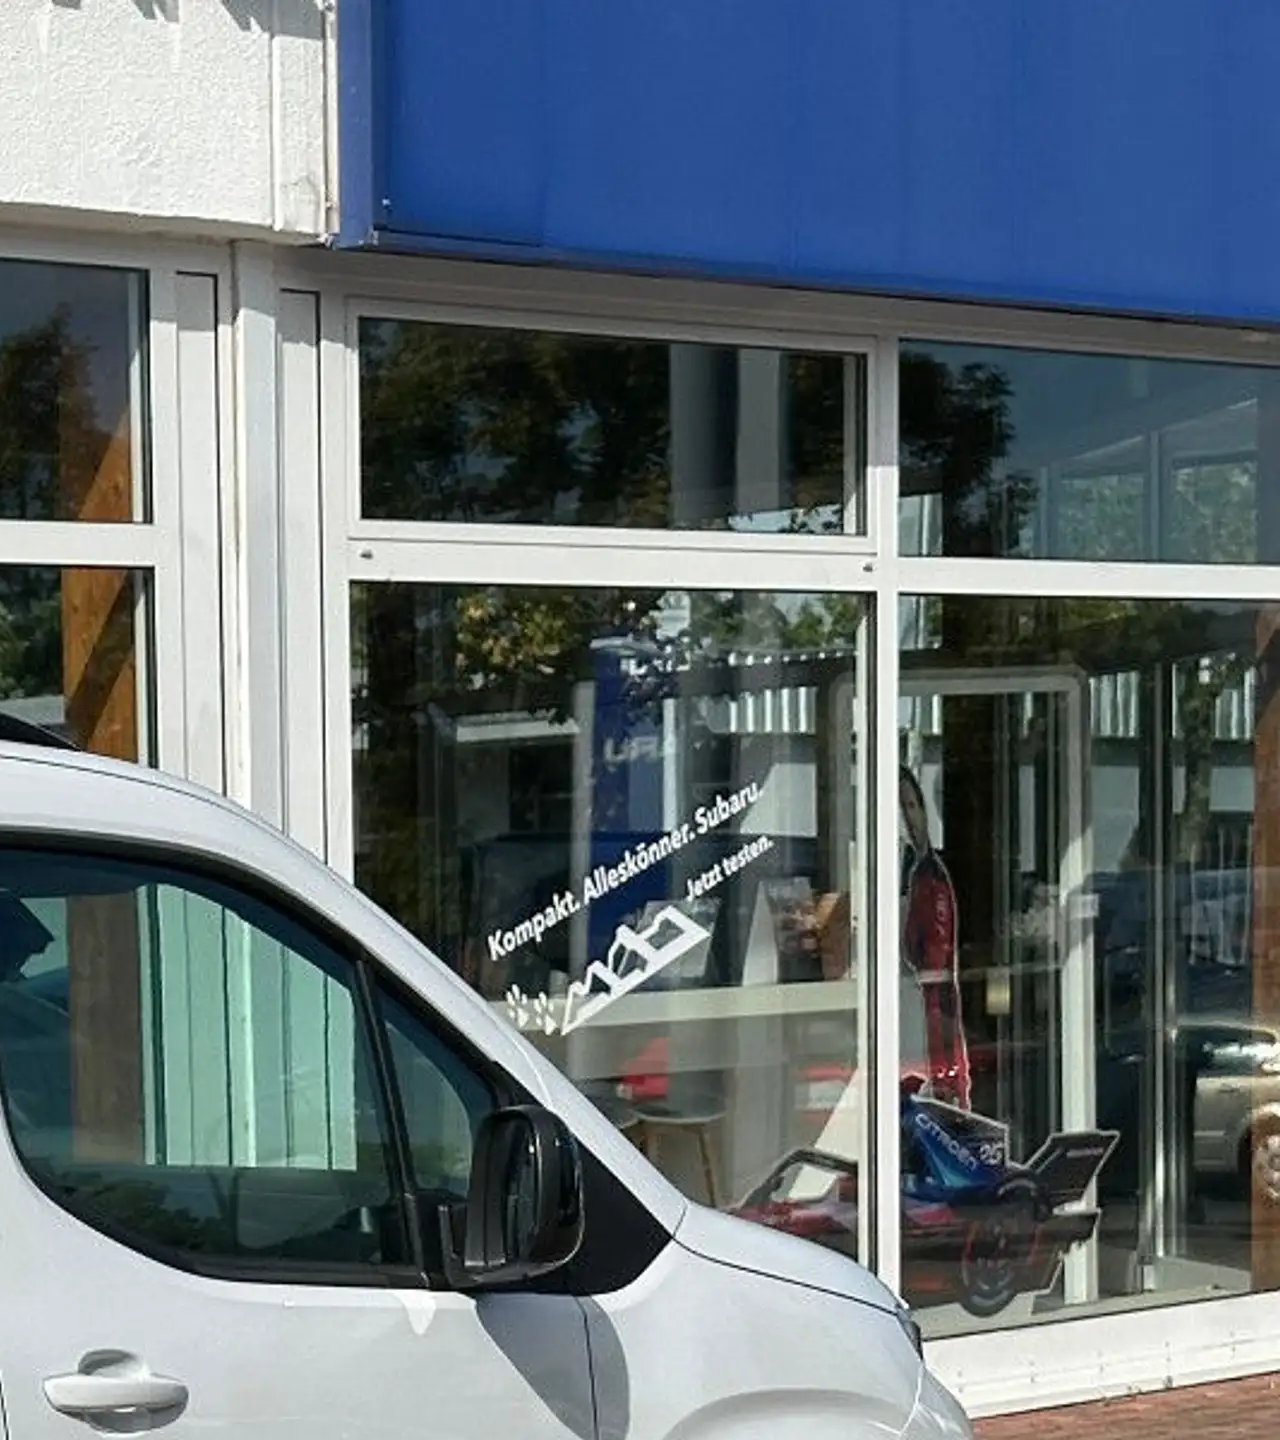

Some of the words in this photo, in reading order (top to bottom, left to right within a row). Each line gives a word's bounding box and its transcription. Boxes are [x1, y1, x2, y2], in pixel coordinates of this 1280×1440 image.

[487, 889, 581, 962] Kompakt.
[583, 821, 696, 905] Alleskönner.
[693, 781, 764, 835] Subaru.
[685, 866, 722, 901] Jetzt
[721, 834, 775, 878] testen.
